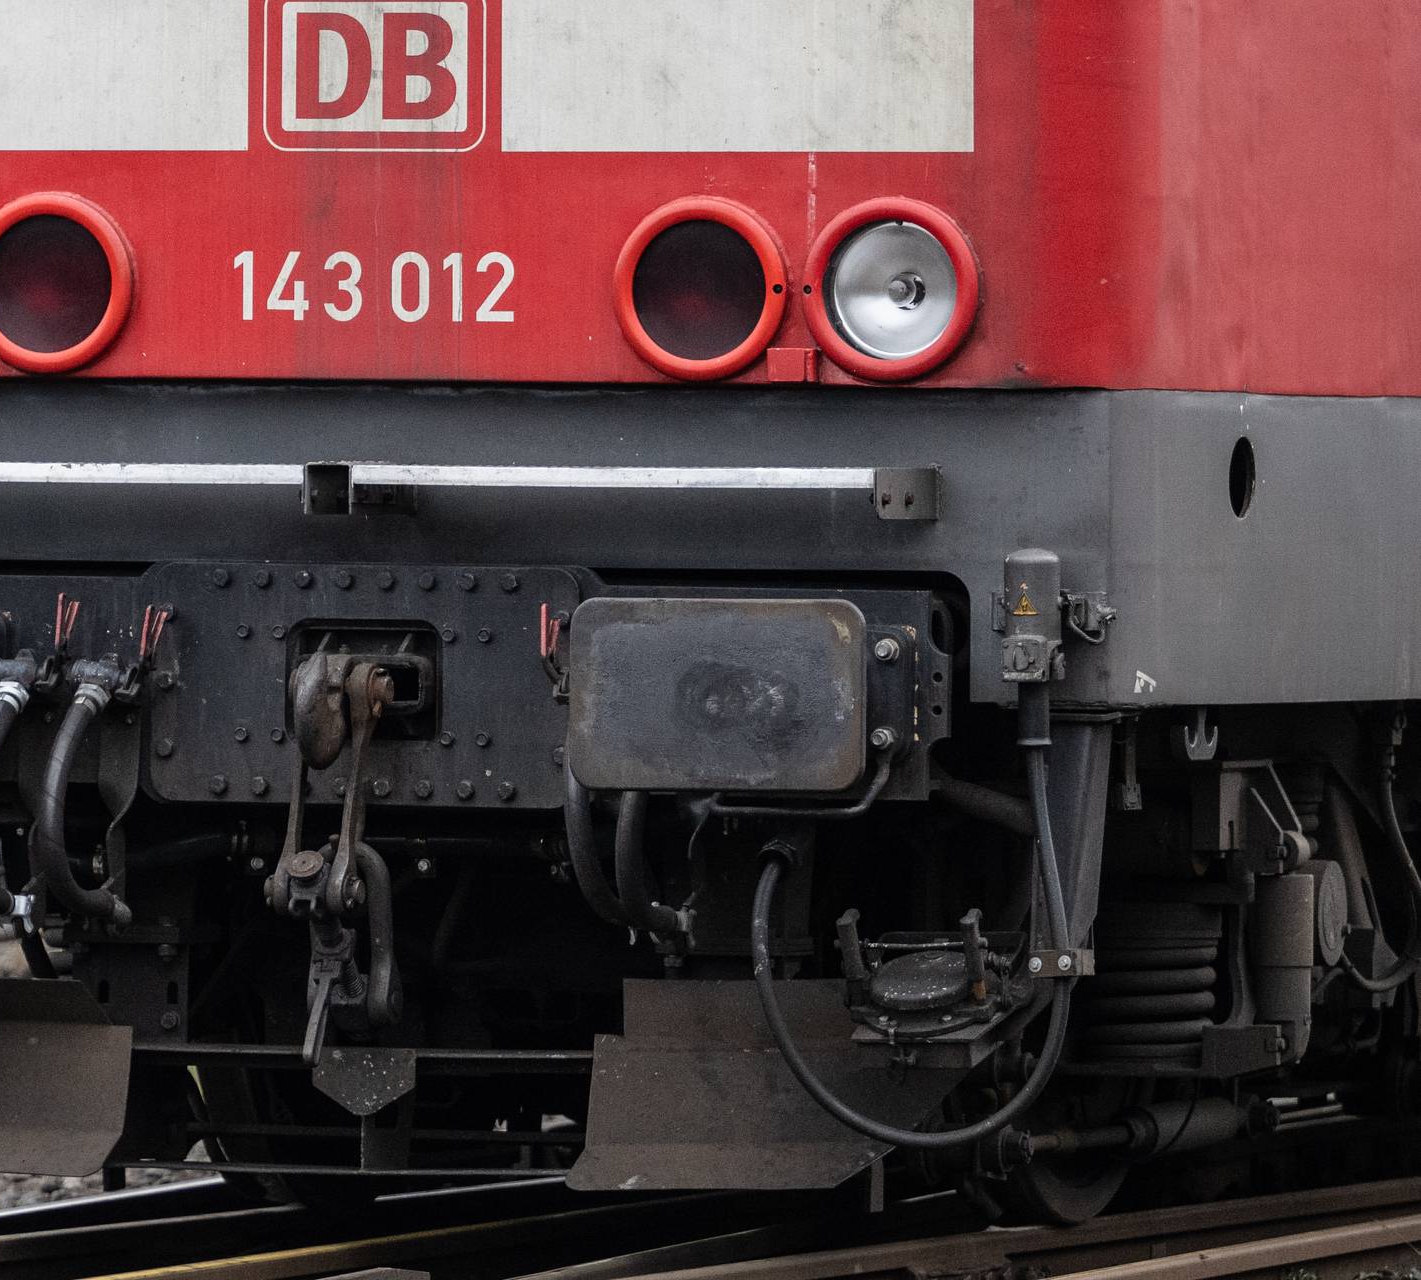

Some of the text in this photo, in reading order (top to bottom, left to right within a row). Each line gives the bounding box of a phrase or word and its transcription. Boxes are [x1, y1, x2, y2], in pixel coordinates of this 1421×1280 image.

[295, 12, 457, 120] DB
[233, 250, 515, 323] 143 012
